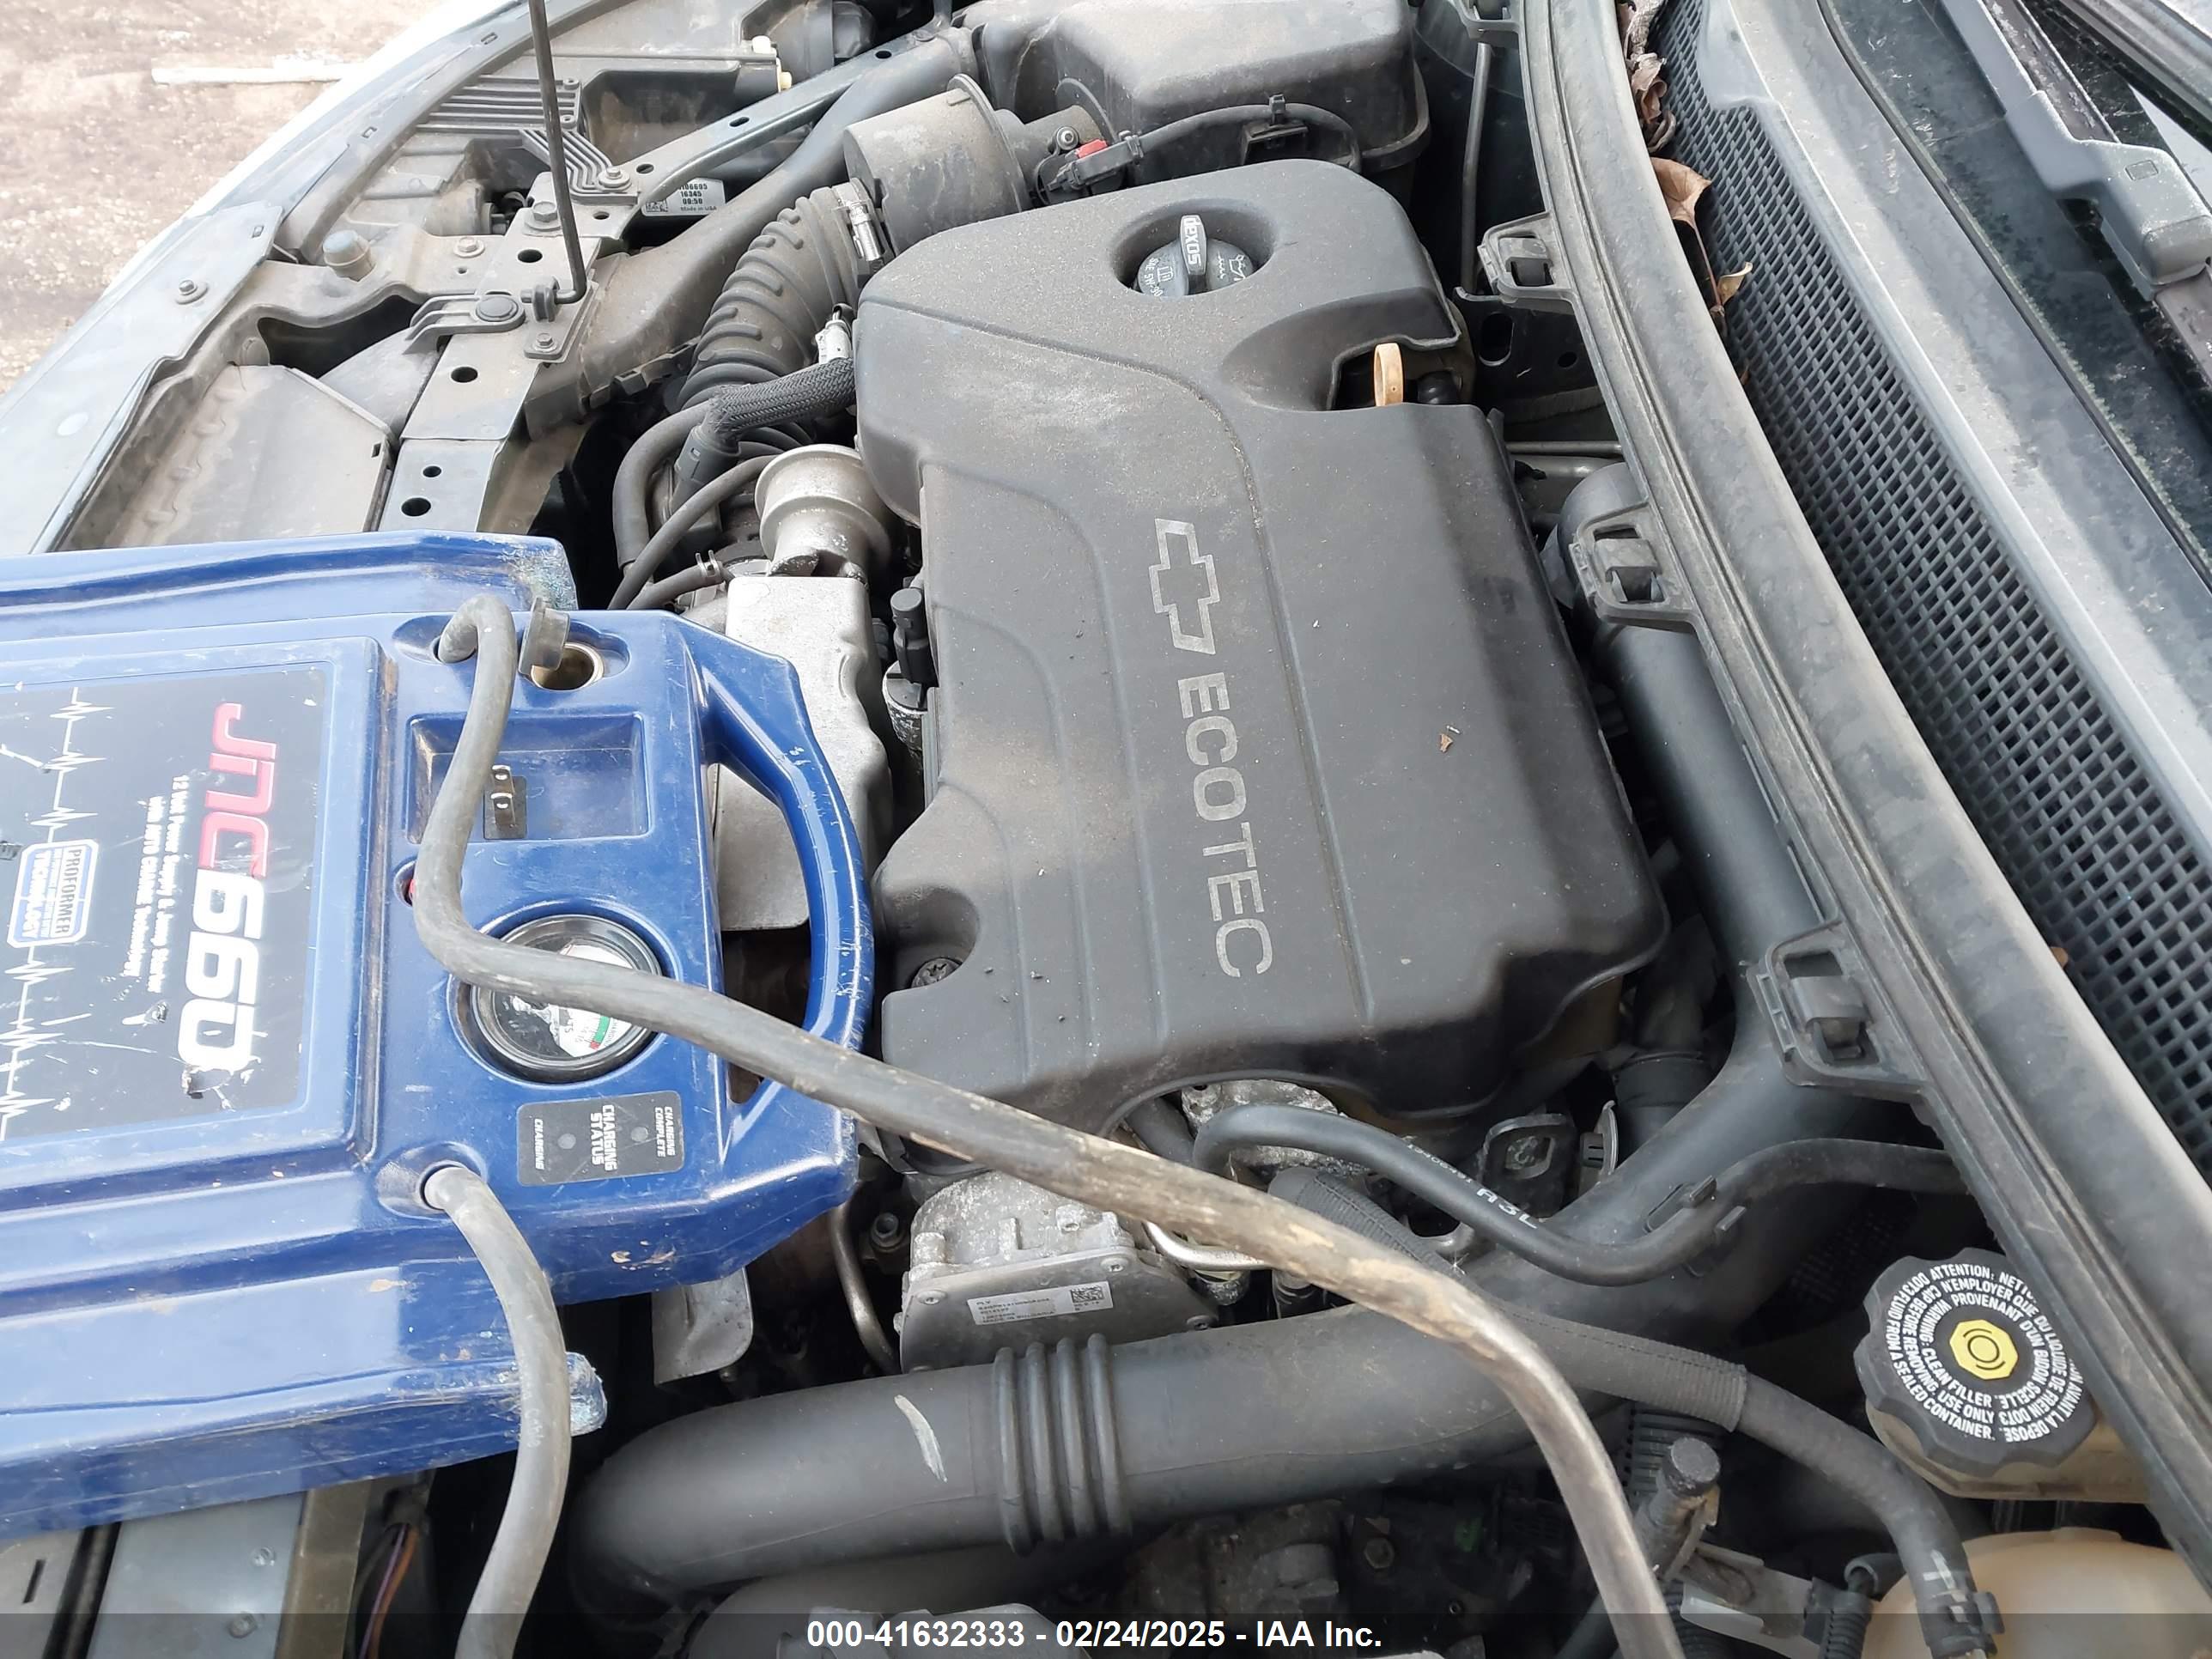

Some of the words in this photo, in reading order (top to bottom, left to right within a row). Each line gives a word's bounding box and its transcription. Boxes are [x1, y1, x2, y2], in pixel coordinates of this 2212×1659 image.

[1182, 216, 1202, 266] dexos
[1145, 257, 1159, 273] SAE
[173, 775, 189, 790] 12
[1177, 672, 1273, 979] ECOTEC
[54, 849, 82, 933] PROFORMER
[533, 1117, 544, 1170] CHARGING
[590, 1112, 603, 1166] STATUS
[602, 1103, 617, 1172] CHARGING
[655, 1106, 665, 1158] COMPLETE
[665, 1105, 675, 1158] CHARGING
[1902, 1272, 1931, 1297] DOT3
[1929, 1263, 1995, 1281] ATTENTION:
[1921, 1285, 1942, 1304] CAP
[1940, 1278, 2014, 1302] N'EMPLOYER
[1887, 1290, 1911, 1321] FLUID
[1902, 1297, 1928, 1336] BEFORE
[1950, 1292, 2025, 1322] PROVENANT
[2012, 1294, 2040, 1318] QUE
[1886, 1319, 1902, 1352] FROM
[1918, 1298, 1953, 1346] WARNING:
[2033, 1315, 2052, 1333] DU
[1889, 1351, 1905, 1361] A
[1902, 1336, 1939, 1395] REMOVING.
[1921, 1346, 1954, 1386] CLEAN
[2031, 1348, 2050, 1385] BIDON
[2045, 1332, 2067, 1377] LIQUIDE
[1893, 1360, 1929, 1402] SEALED
[1947, 1380, 1992, 1408] FILLER
[1994, 1381, 2041, 1410] SCELLE.
[2048, 1376, 2066, 1393] DE
[1937, 1389, 1963, 1413] USE
[1962, 1406, 1995, 1425] ONLY
[2027, 1389, 2059, 1418] FREIN
[2056, 1382, 2083, 1419] AVANT
[1923, 1397, 1996, 1441] CONTAINER.
[1998, 1407, 2032, 1425] DOT3
[1999, 1419, 2051, 1443] DEPOSE.
[2044, 1410, 2065, 1429] LA
